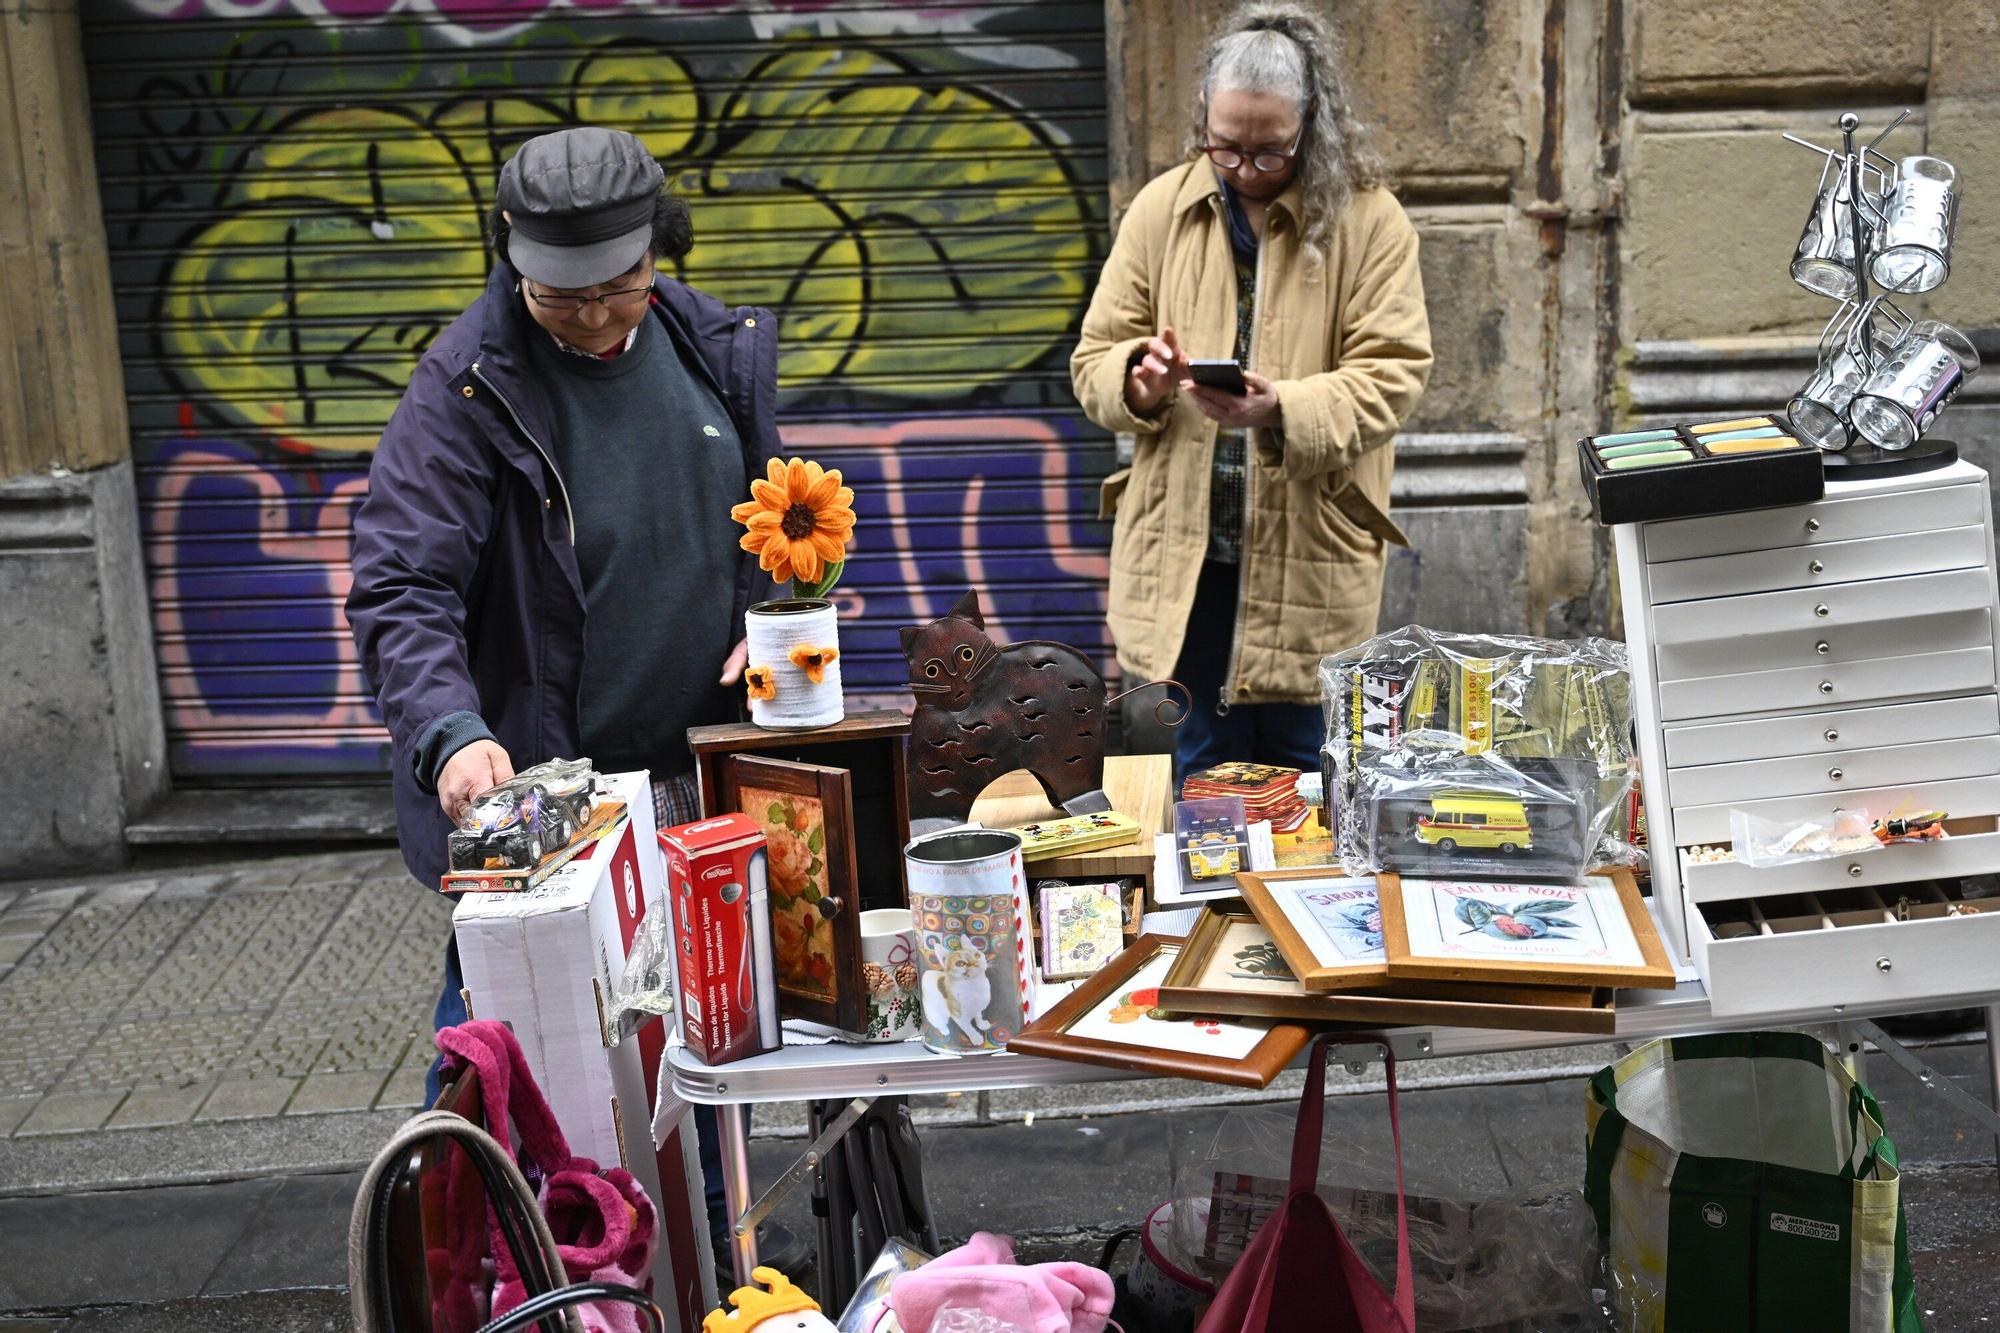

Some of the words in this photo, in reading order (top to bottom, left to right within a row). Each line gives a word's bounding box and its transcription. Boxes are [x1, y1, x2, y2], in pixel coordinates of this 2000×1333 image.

[1352, 684, 1362, 733] asistencia
[1363, 672, 1389, 751] LYE
[943, 867, 970, 876] FAVOR
[1306, 889, 1364, 906] SIROP
[1491, 884, 1520, 894] DE
[1528, 885, 1578, 900] NOIX
[702, 897, 711, 929] Liquides
[704, 931, 713, 948] pour
[715, 921, 725, 975] Thermoflasche
[706, 949, 715, 978] Thermo
[720, 983, 730, 1009] Liquids
[710, 1016, 718, 1025] de
[722, 1010, 730, 1021] for
[712, 1026, 720, 1049] Termo
[723, 1022, 732, 1050] Thermo
[1788, 1218, 1836, 1231] MERCADONA
[1788, 1224, 1803, 1233] 800
[1804, 1227, 1820, 1236] 500
[1821, 1230, 1836, 1239] 220
